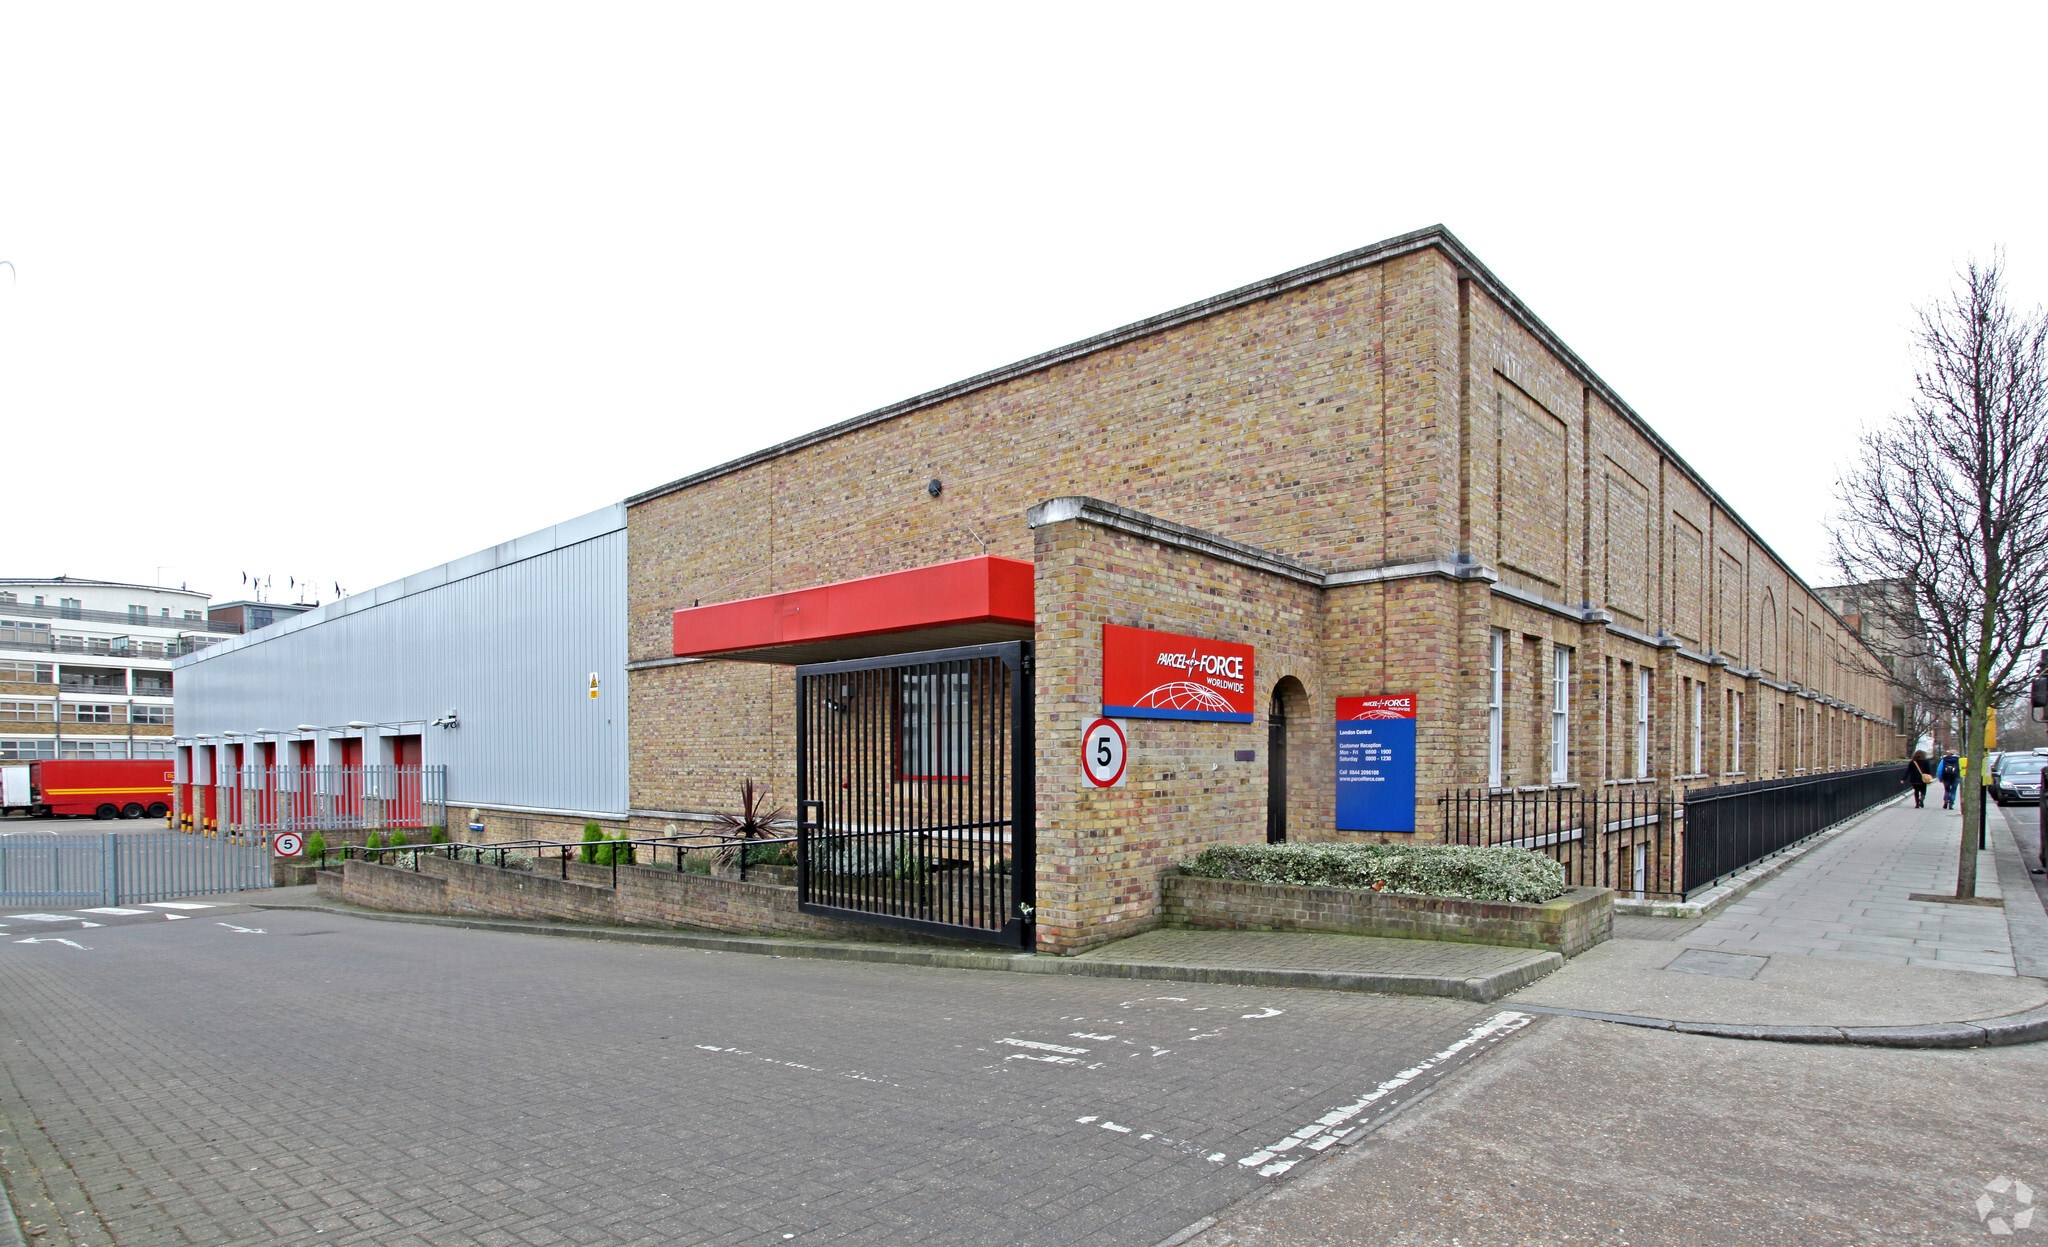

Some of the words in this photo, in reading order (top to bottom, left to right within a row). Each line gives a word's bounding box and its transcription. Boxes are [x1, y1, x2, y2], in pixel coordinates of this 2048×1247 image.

[1157, 652, 1187, 669] PARCEL
[1199, 655, 1244, 679] FORCE
[1206, 676, 1244, 693] WORLDWIDE
[1384, 698, 1411, 707] FORCE
[1097, 737, 1112, 766] 5
[283, 839, 293, 850] 5
